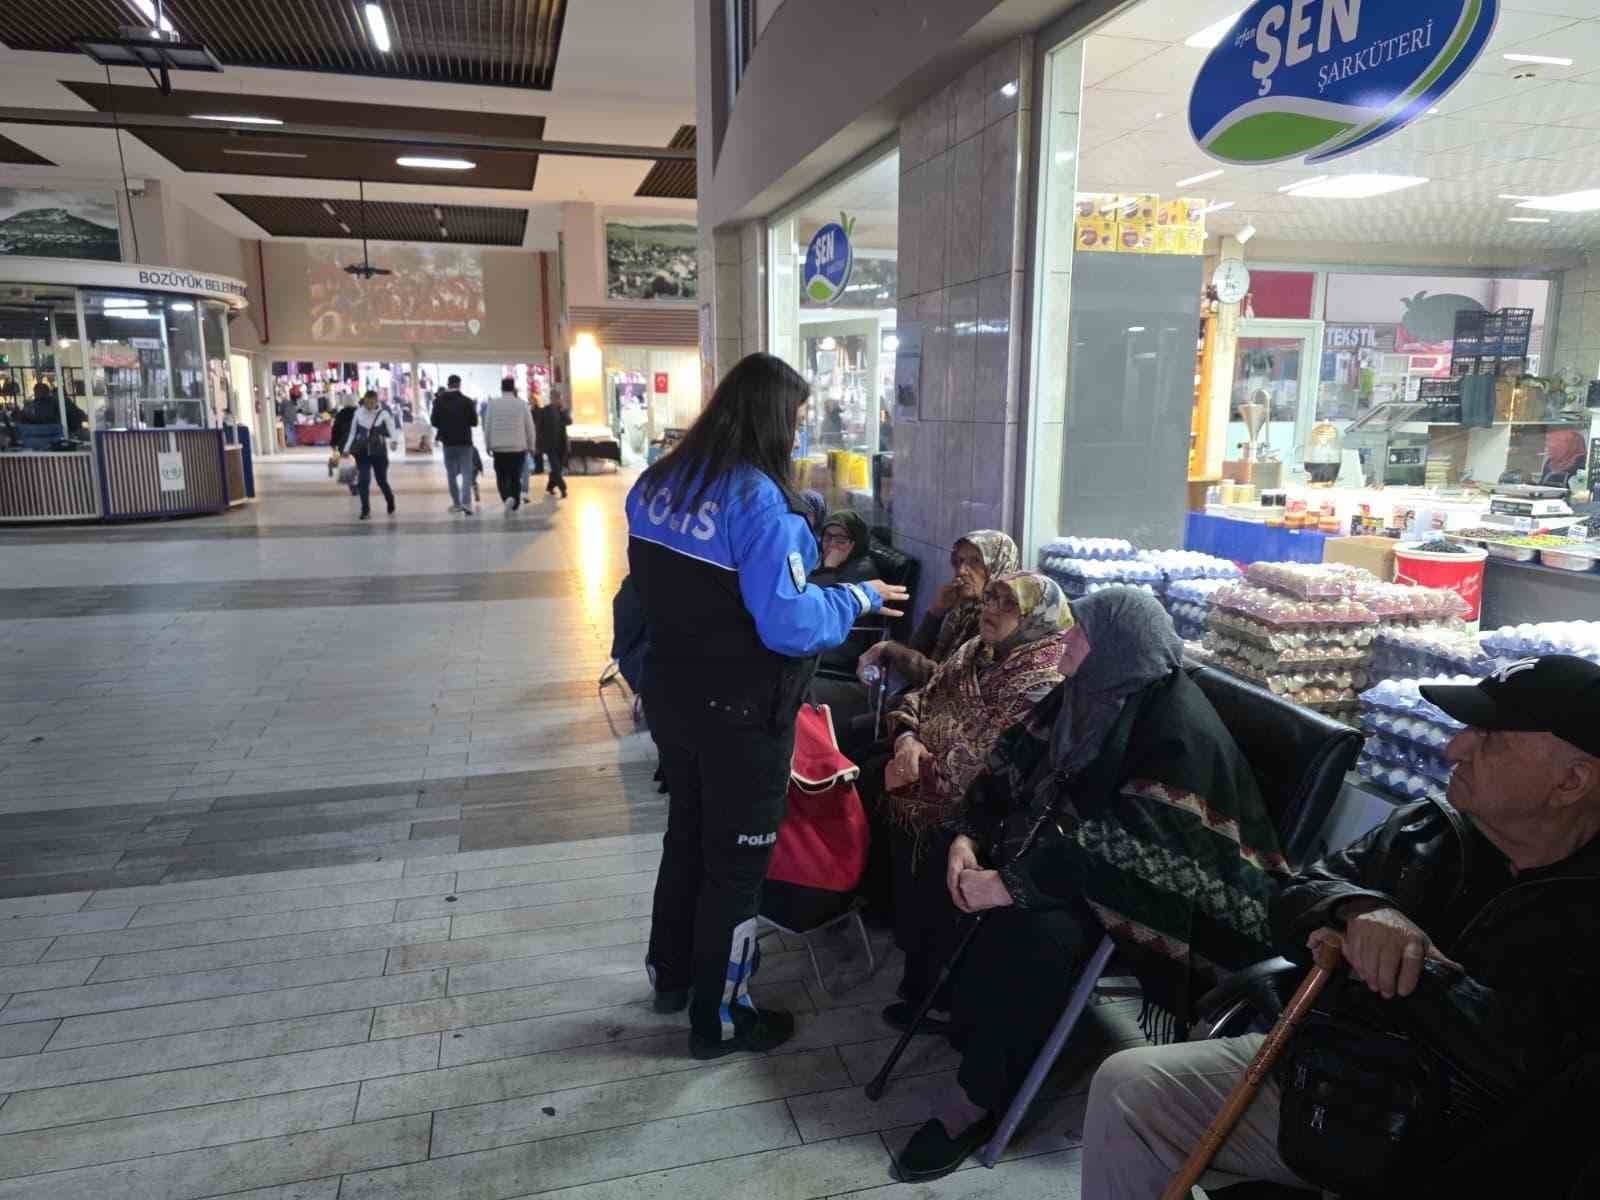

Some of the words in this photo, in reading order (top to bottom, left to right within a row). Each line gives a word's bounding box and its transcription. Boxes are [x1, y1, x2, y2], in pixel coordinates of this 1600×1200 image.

[1252, 0, 1361, 97] ŞEN
[1317, 18, 1434, 94] ŞARKÜTERİ
[139, 271, 203, 289] BOZÜYÜK
